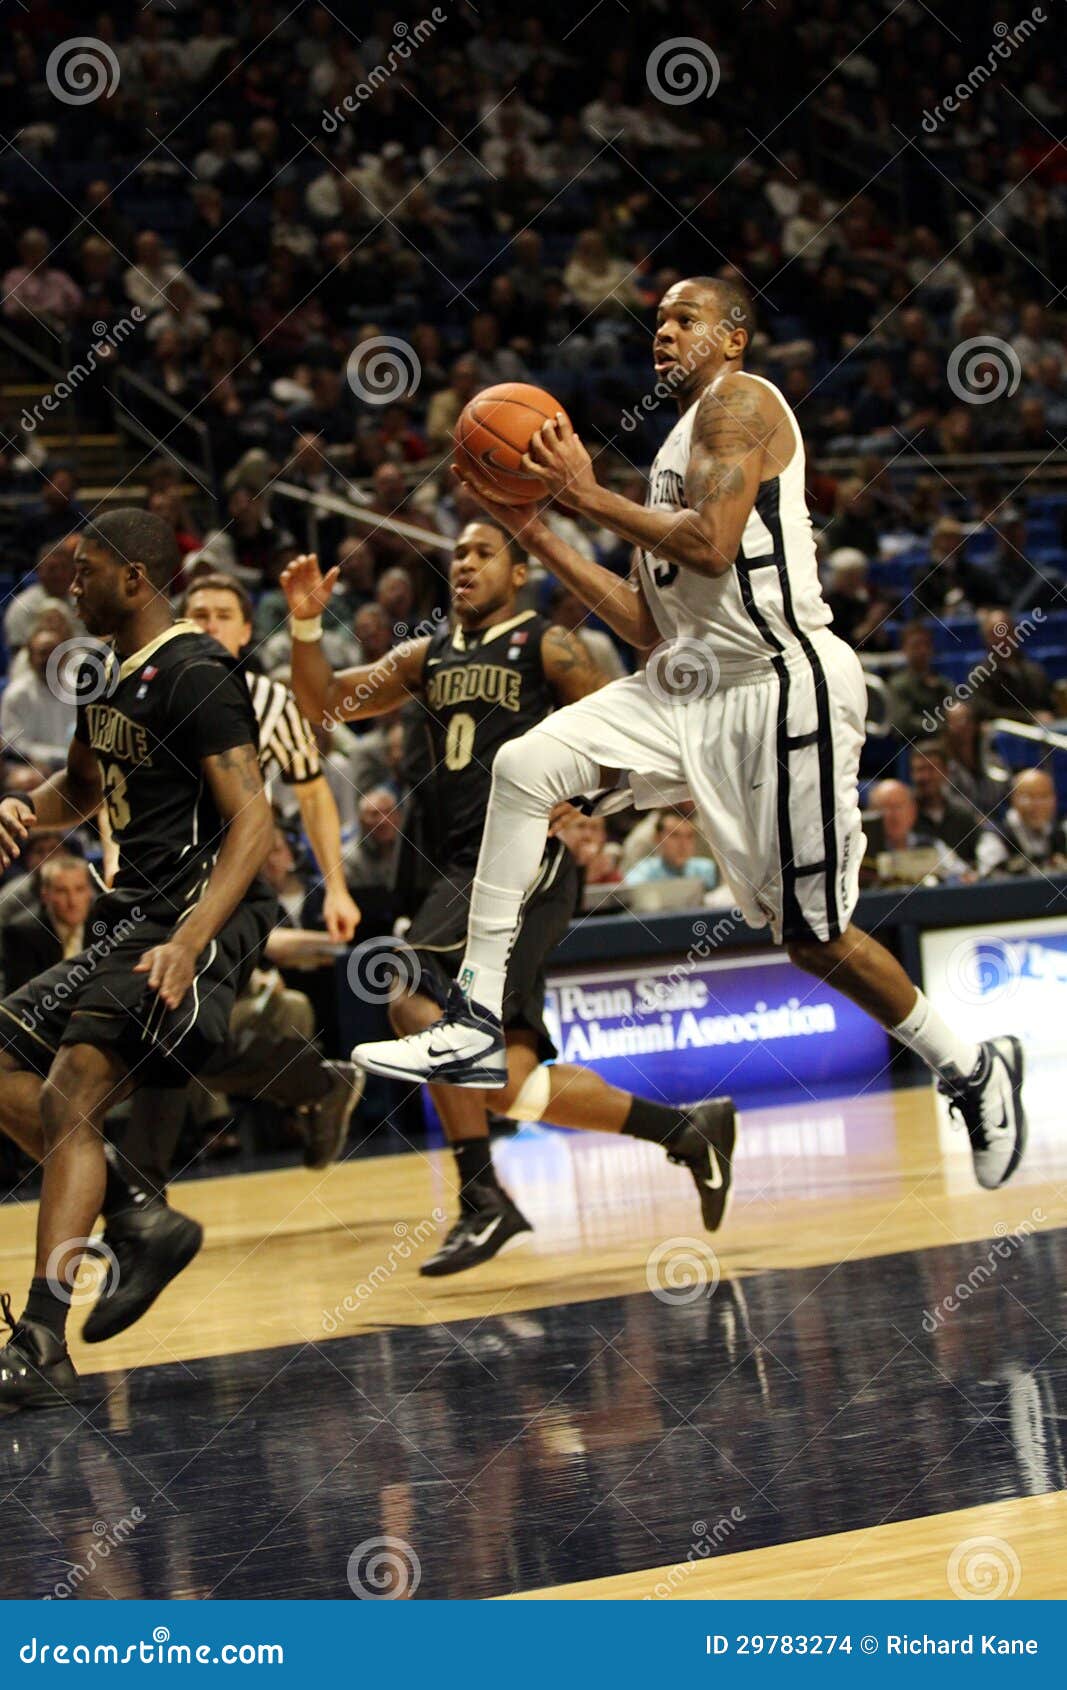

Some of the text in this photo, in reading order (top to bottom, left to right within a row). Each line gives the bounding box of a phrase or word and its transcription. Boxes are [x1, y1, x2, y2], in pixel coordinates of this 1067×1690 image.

[445, 712, 476, 771] 0
[560, 979, 709, 1024] Penn State
[564, 998, 836, 1063] Alumni Association
